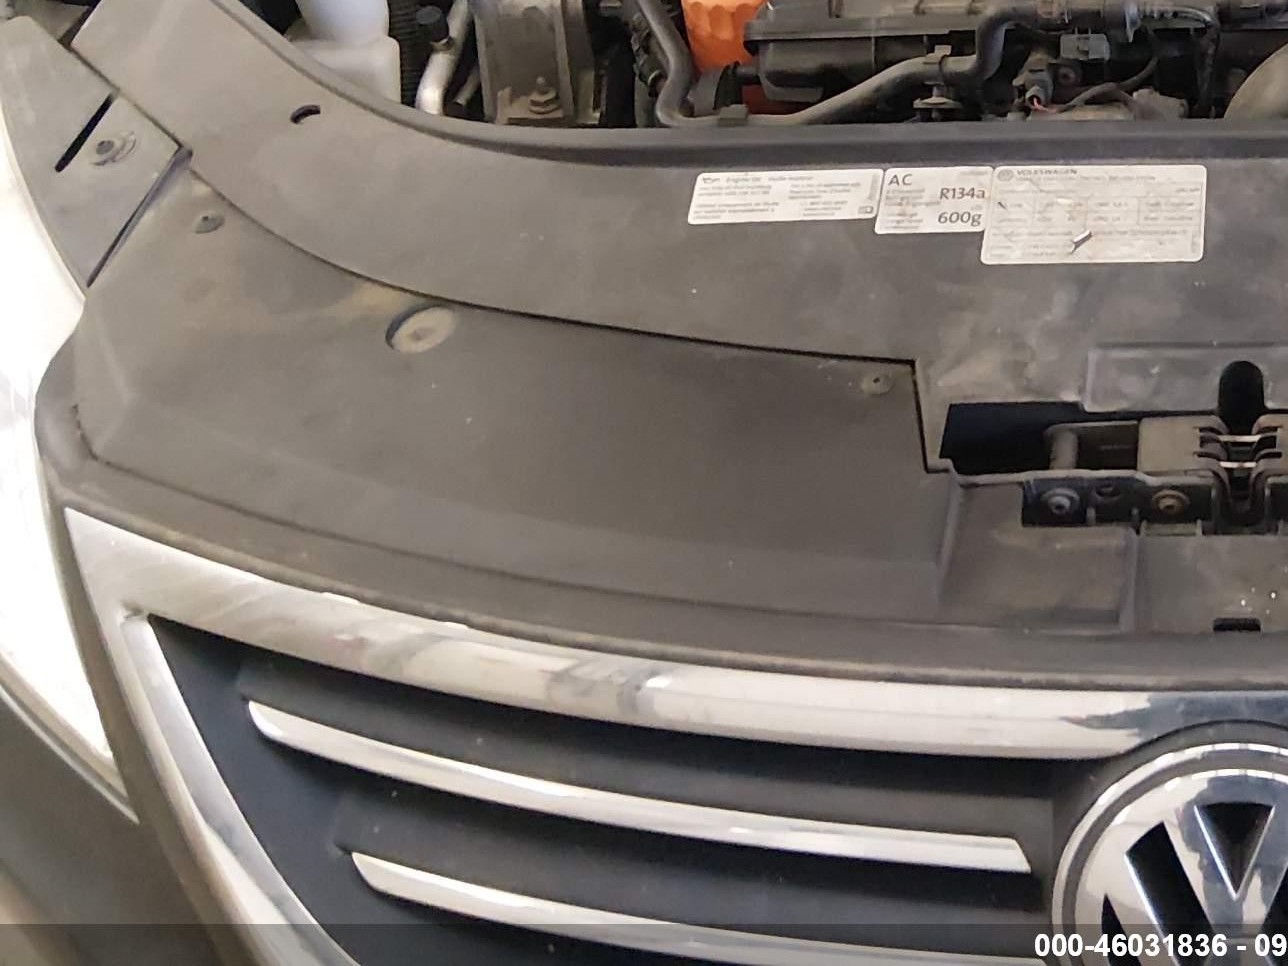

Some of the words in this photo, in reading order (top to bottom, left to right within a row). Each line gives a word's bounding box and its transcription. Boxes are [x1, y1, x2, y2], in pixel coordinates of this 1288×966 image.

[888, 173, 913, 186] AC
[939, 187, 986, 200] R134a
[937, 211, 982, 227] 600g
